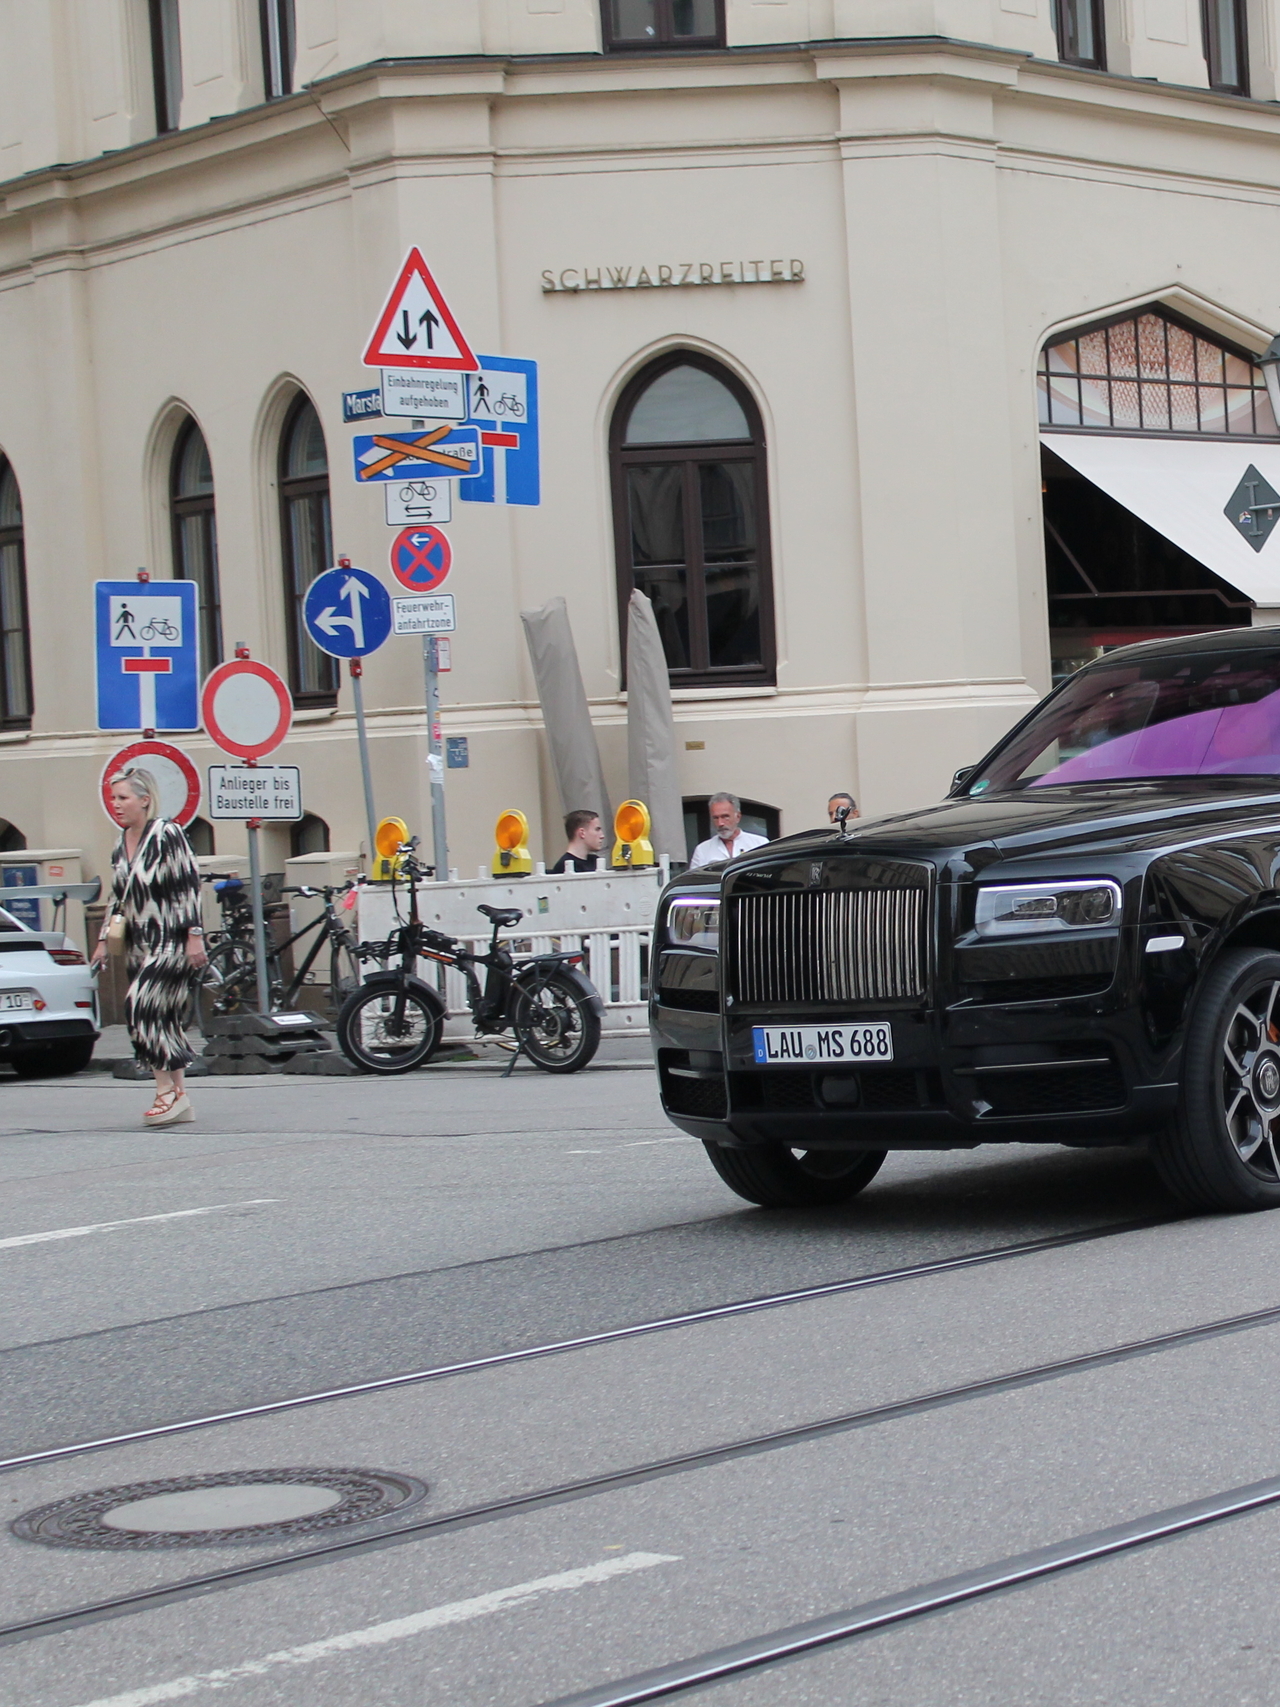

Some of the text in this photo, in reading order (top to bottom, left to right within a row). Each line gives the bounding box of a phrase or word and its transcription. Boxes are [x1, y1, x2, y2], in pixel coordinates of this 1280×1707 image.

[541, 259, 805, 292] SCHWARZREITER
[388, 375, 458, 394] Einbahnregelung
[399, 395, 449, 409] aufgehoben
[396, 600, 450, 613] Feuerwehr-
[397, 618, 452, 630] anfahrtzone
[219, 776, 290, 793] Anlieger bis
[216, 795, 294, 809] Baustelle frei
[6, 994, 22, 1008] 10
[766, 1031, 803, 1059] LAU
[817, 1030, 844, 1058] MS
[851, 1028, 889, 1056] 688
